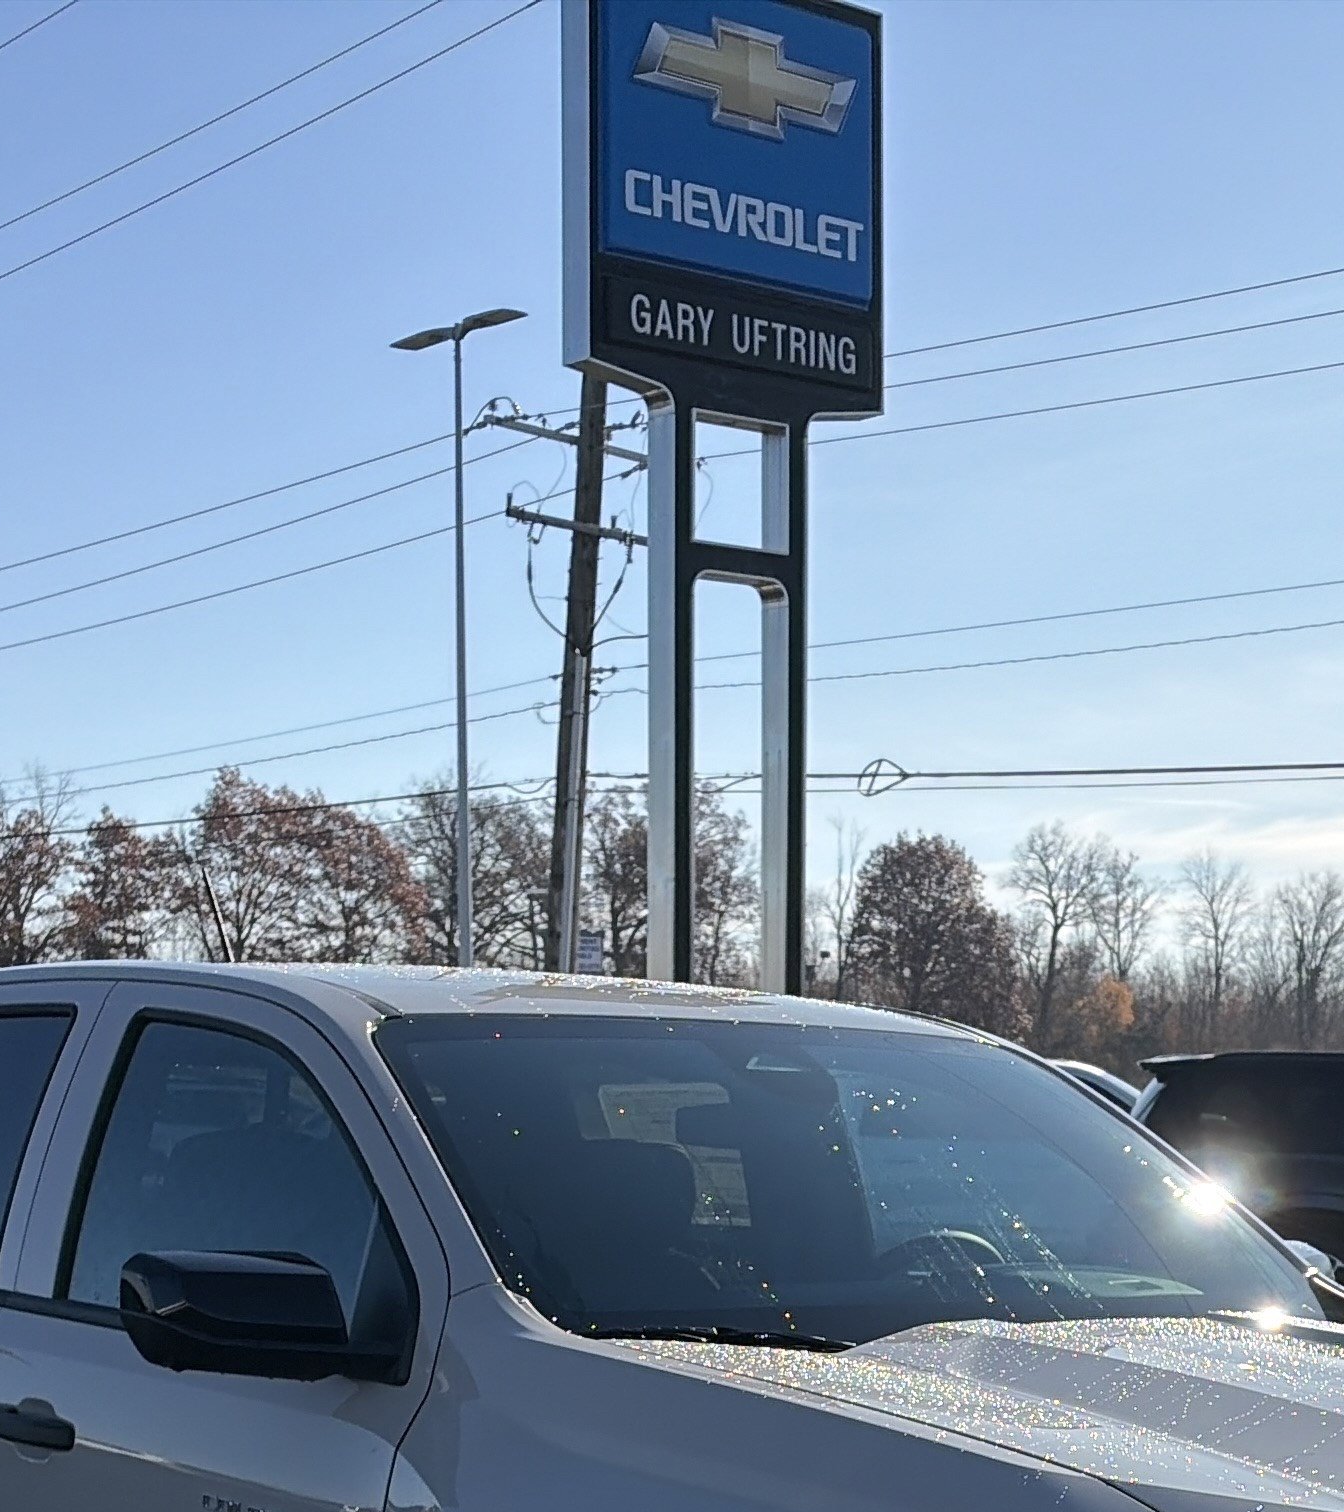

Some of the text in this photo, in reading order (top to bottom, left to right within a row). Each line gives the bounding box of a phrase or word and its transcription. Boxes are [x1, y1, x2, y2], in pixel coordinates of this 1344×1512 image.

[625, 169, 864, 262] CHEVROLET
[630, 293, 857, 375] GARY UFTRING
